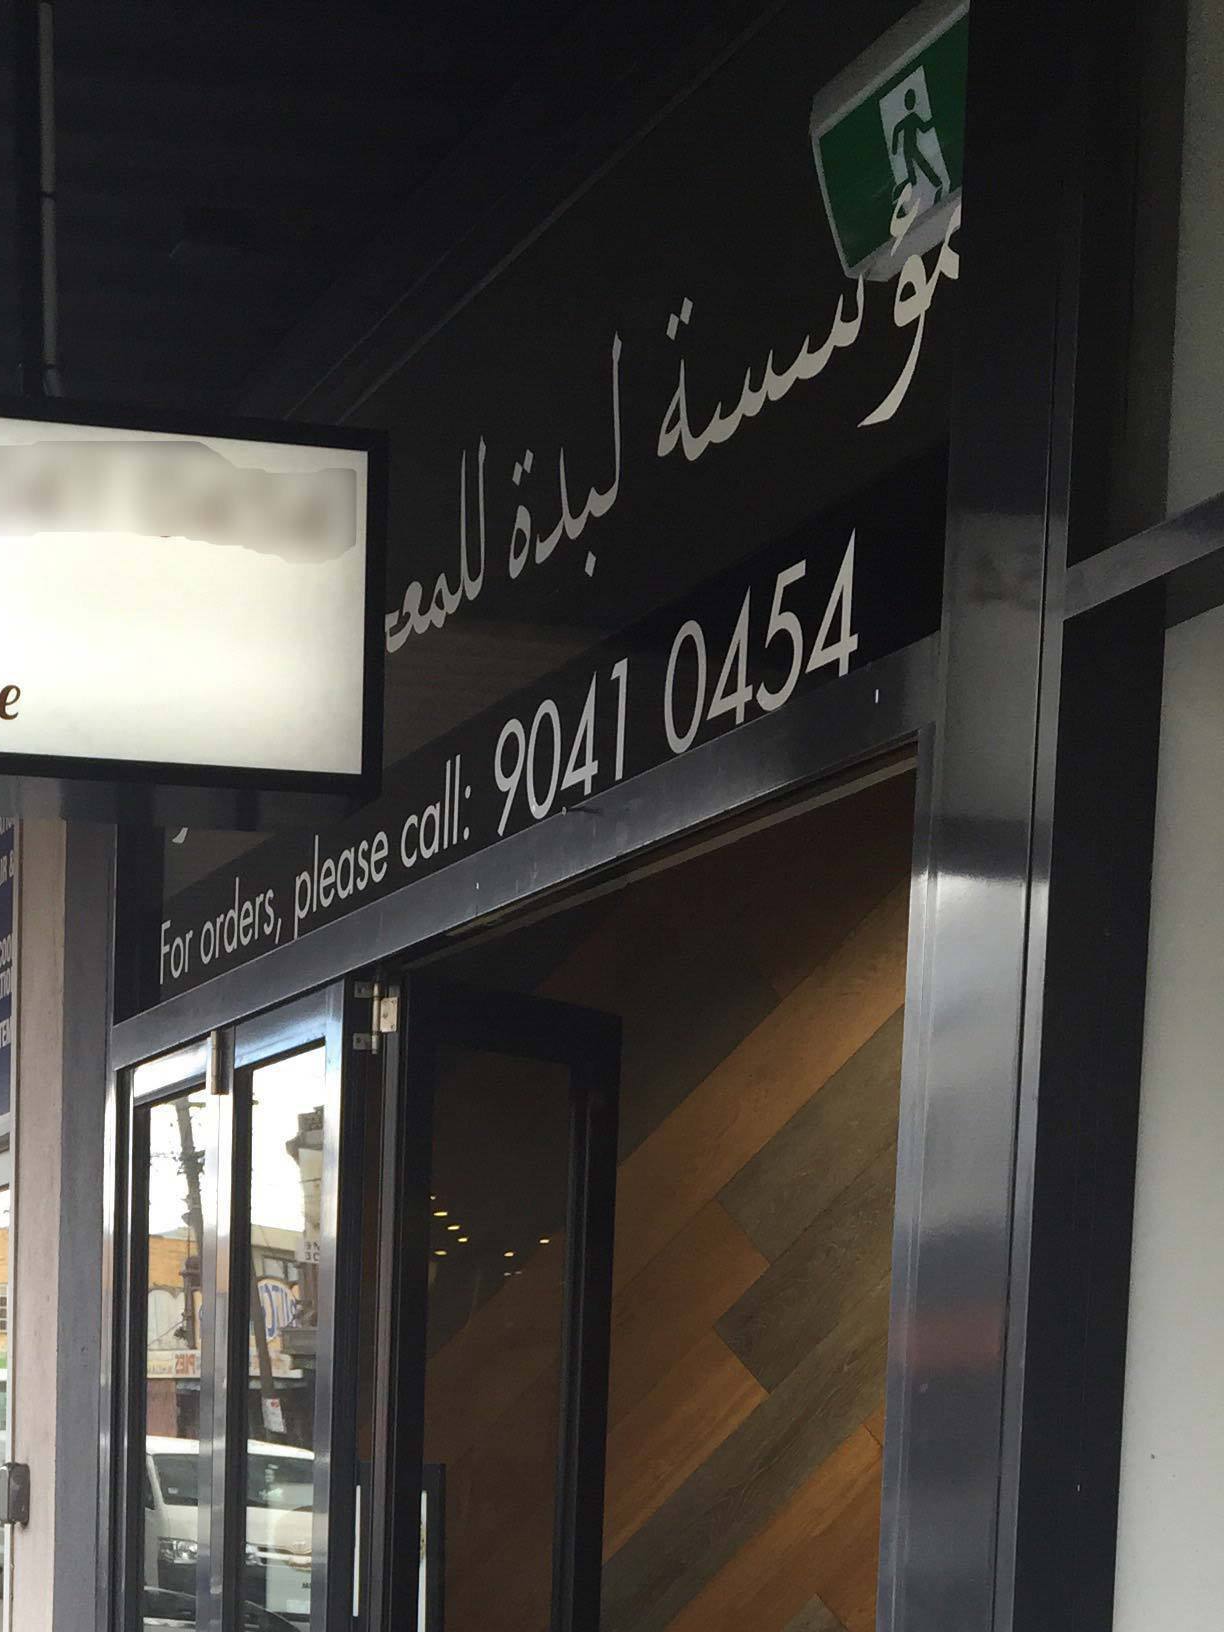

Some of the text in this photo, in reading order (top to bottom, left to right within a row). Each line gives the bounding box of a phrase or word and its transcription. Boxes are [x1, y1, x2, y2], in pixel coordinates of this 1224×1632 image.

[159, 528, 859, 985] For orders, please call: 9041 0454
